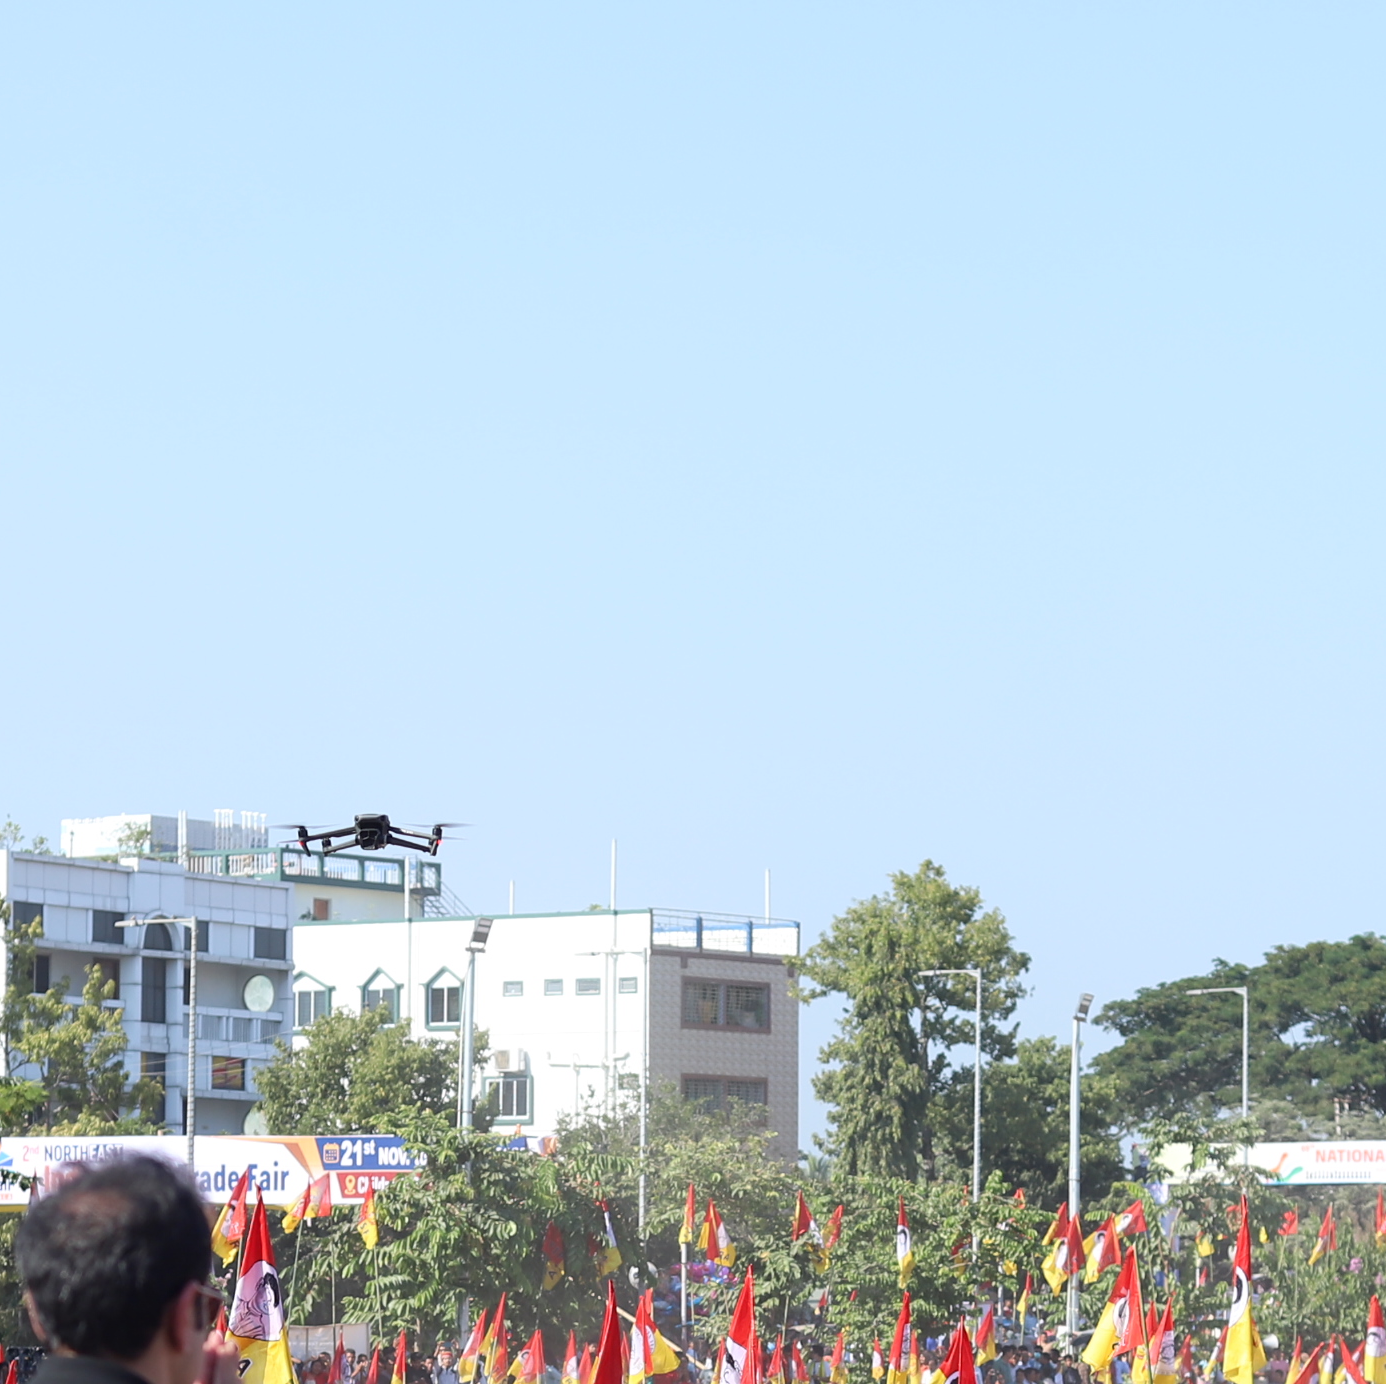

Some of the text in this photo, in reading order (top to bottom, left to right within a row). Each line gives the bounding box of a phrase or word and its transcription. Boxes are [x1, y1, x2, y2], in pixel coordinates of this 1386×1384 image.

[23, 1145, 40, 1162] 2nd
[340, 1139, 376, 1166] 21st
[194, 1161, 290, 1193] rade Fair
